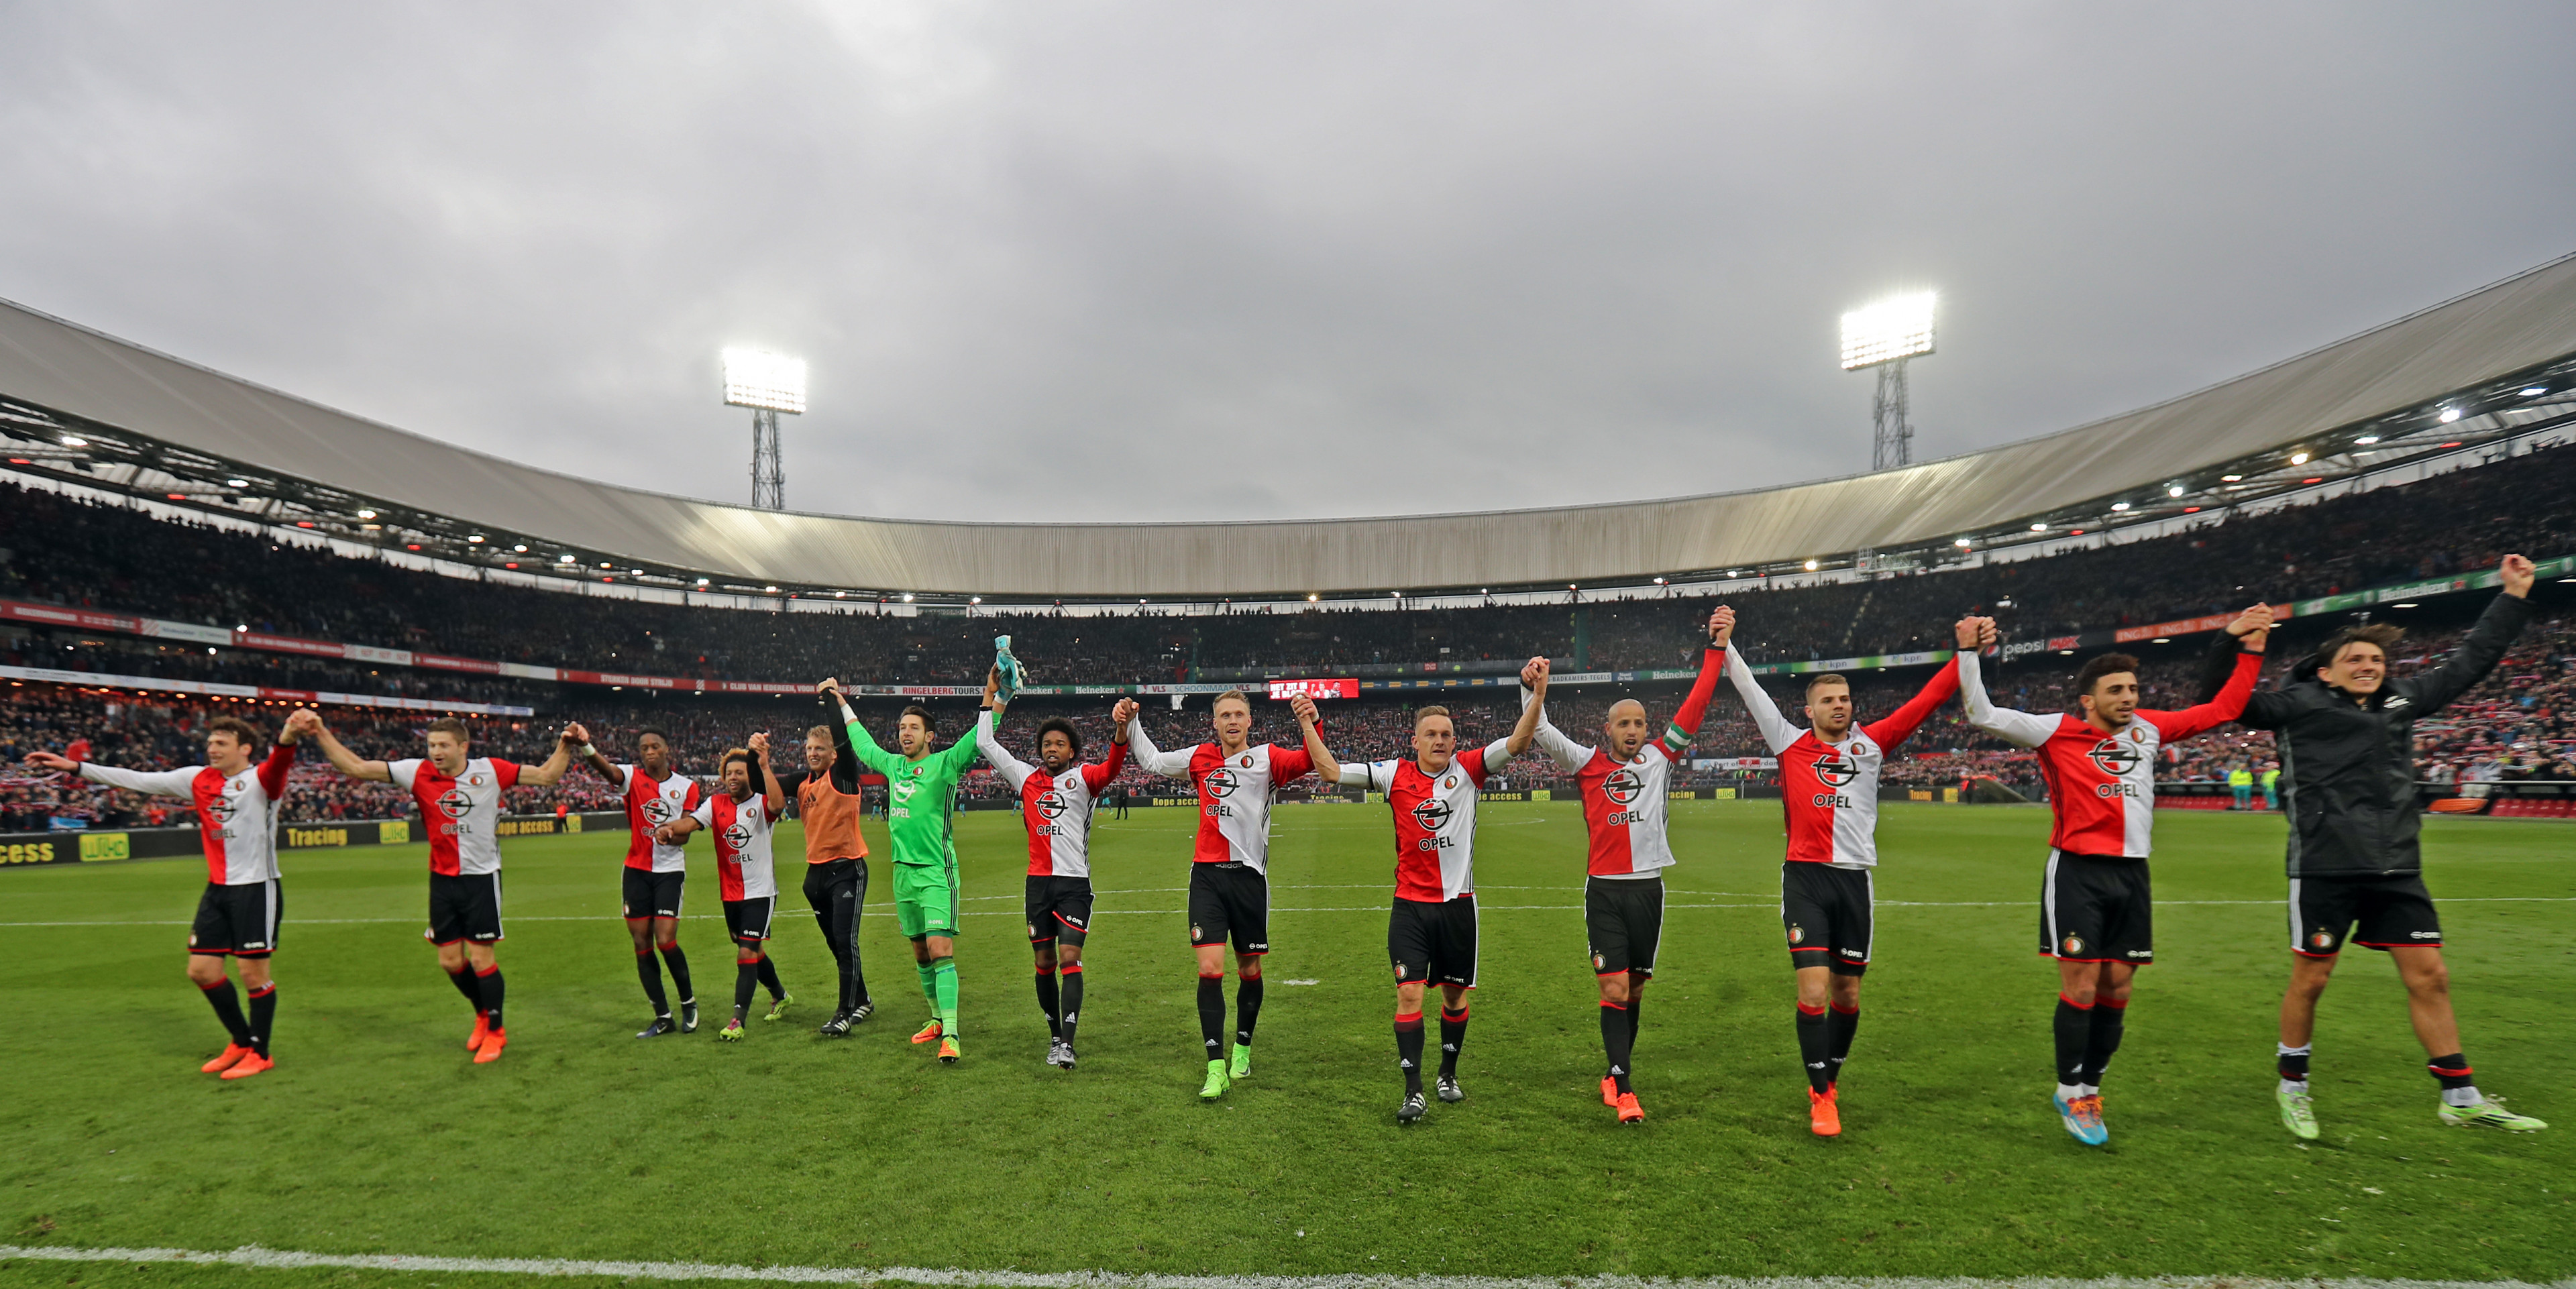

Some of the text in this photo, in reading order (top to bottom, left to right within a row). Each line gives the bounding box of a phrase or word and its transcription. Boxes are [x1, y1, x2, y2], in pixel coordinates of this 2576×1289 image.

[2378, 583, 2450, 602] Heineken
[2202, 618, 2225, 629] ING
[2118, 630, 2141, 641] ING
[2159, 625, 2179, 636] ING
[2004, 640, 2045, 655] pepsi
[1904, 653, 1922, 663] kpn
[1830, 661, 1847, 669] kpn
[1653, 671, 1697, 679] Heineken
[631, 677, 649, 685] DOOR
[748, 683, 761, 691] VAN
[1016, 686, 1053, 694] eineken
[1075, 686, 1116, 694] Heineken
[1270, 683, 1285, 691] HET
[1715, 759, 1729, 768] Port
[1910, 790, 1932, 801] Tracing
[2097, 783, 2139, 799] OPEL
[1153, 797, 1174, 806] Rope
[1813, 794, 1851, 808] OPEL
[891, 806, 910, 818] OPEL
[1206, 805, 1233, 817] OPEL
[1608, 810, 1644, 825] OPEL
[441, 823, 472, 834] OPEL
[519, 820, 554, 834] access
[641, 826, 656, 837] OP
[1037, 826, 1063, 835] OPEL
[211, 829, 235, 840] OPEL
[288, 828, 347, 846] Tracing
[1419, 836, 1454, 851] OPEL
[729, 852, 753, 864] OPEL
[1071, 917, 1083, 926] OPEL
